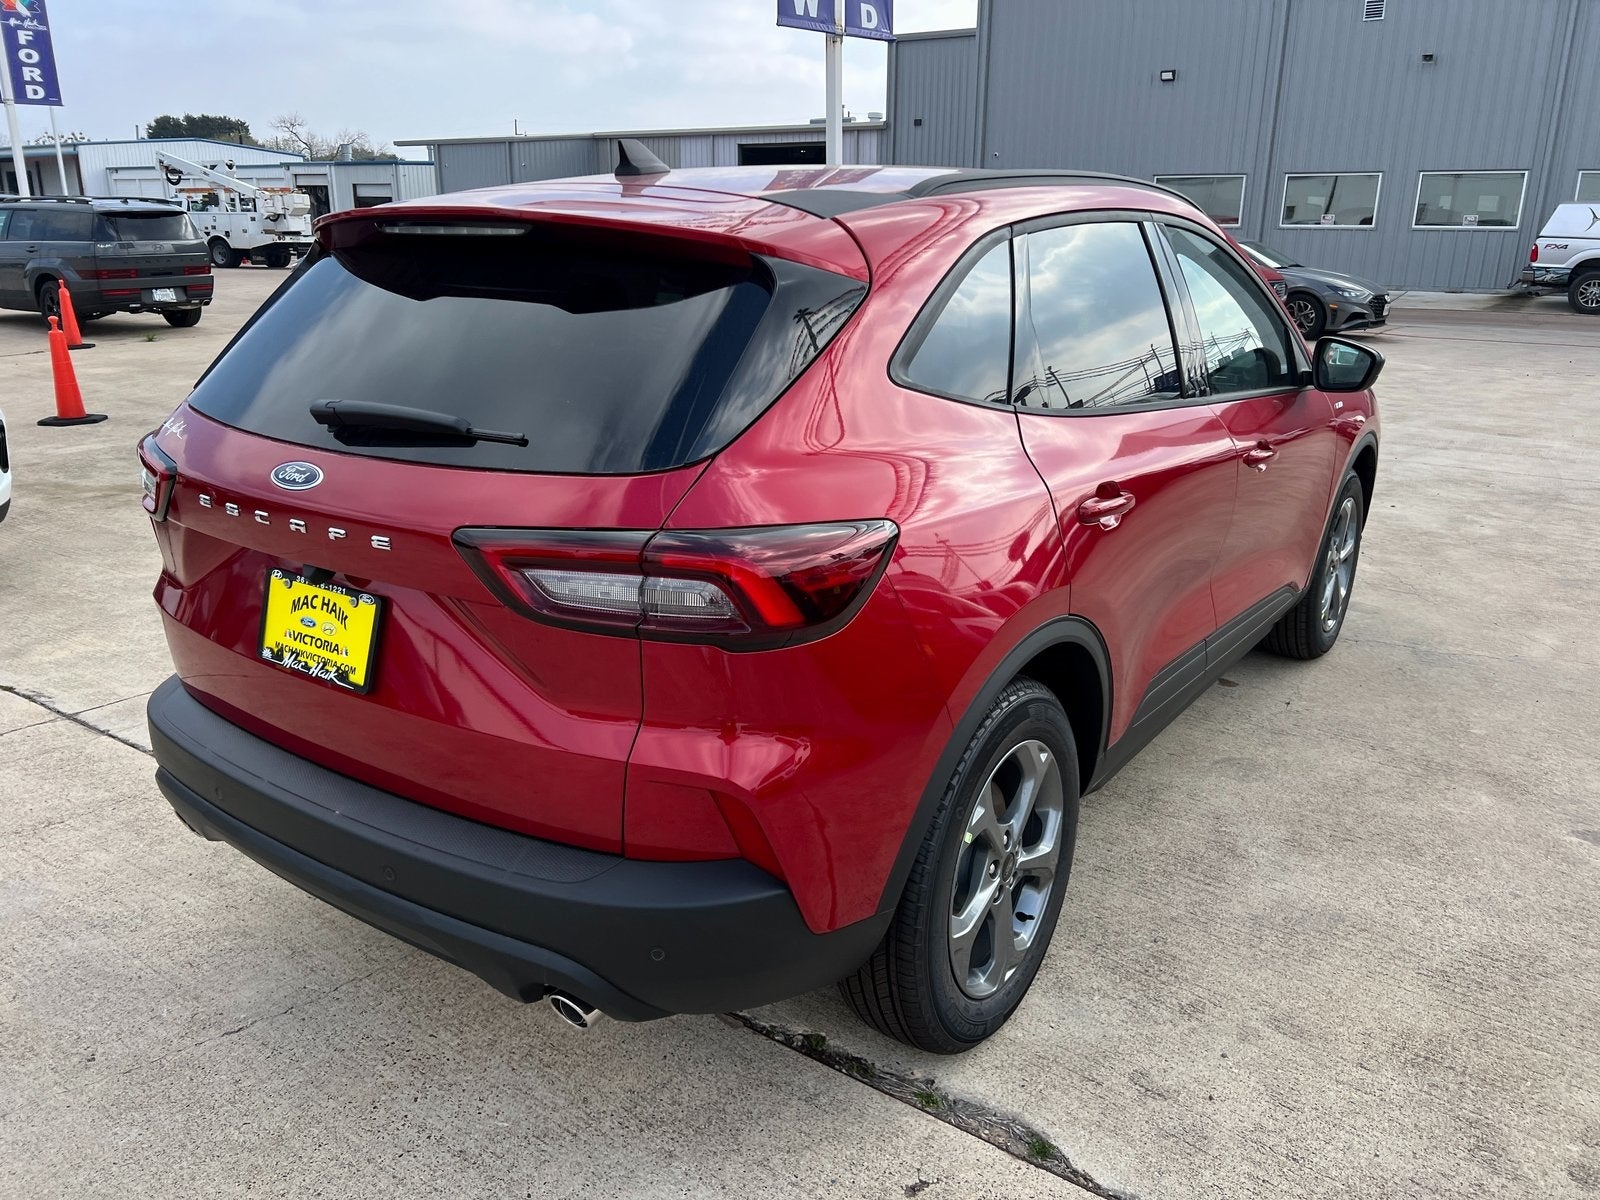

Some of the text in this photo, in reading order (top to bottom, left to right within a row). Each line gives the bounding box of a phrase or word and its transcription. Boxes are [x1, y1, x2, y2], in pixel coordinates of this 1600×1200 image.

[860, 3, 878, 29] D
[17, 30, 45, 99] FORD
[279, 465, 310, 483] Ford
[199, 494, 392, 551] ESCAPE
[291, 595, 348, 630] MAC HAIK
[292, 630, 340, 655] VICTORIA
[282, 651, 347, 685] Mac Haik
